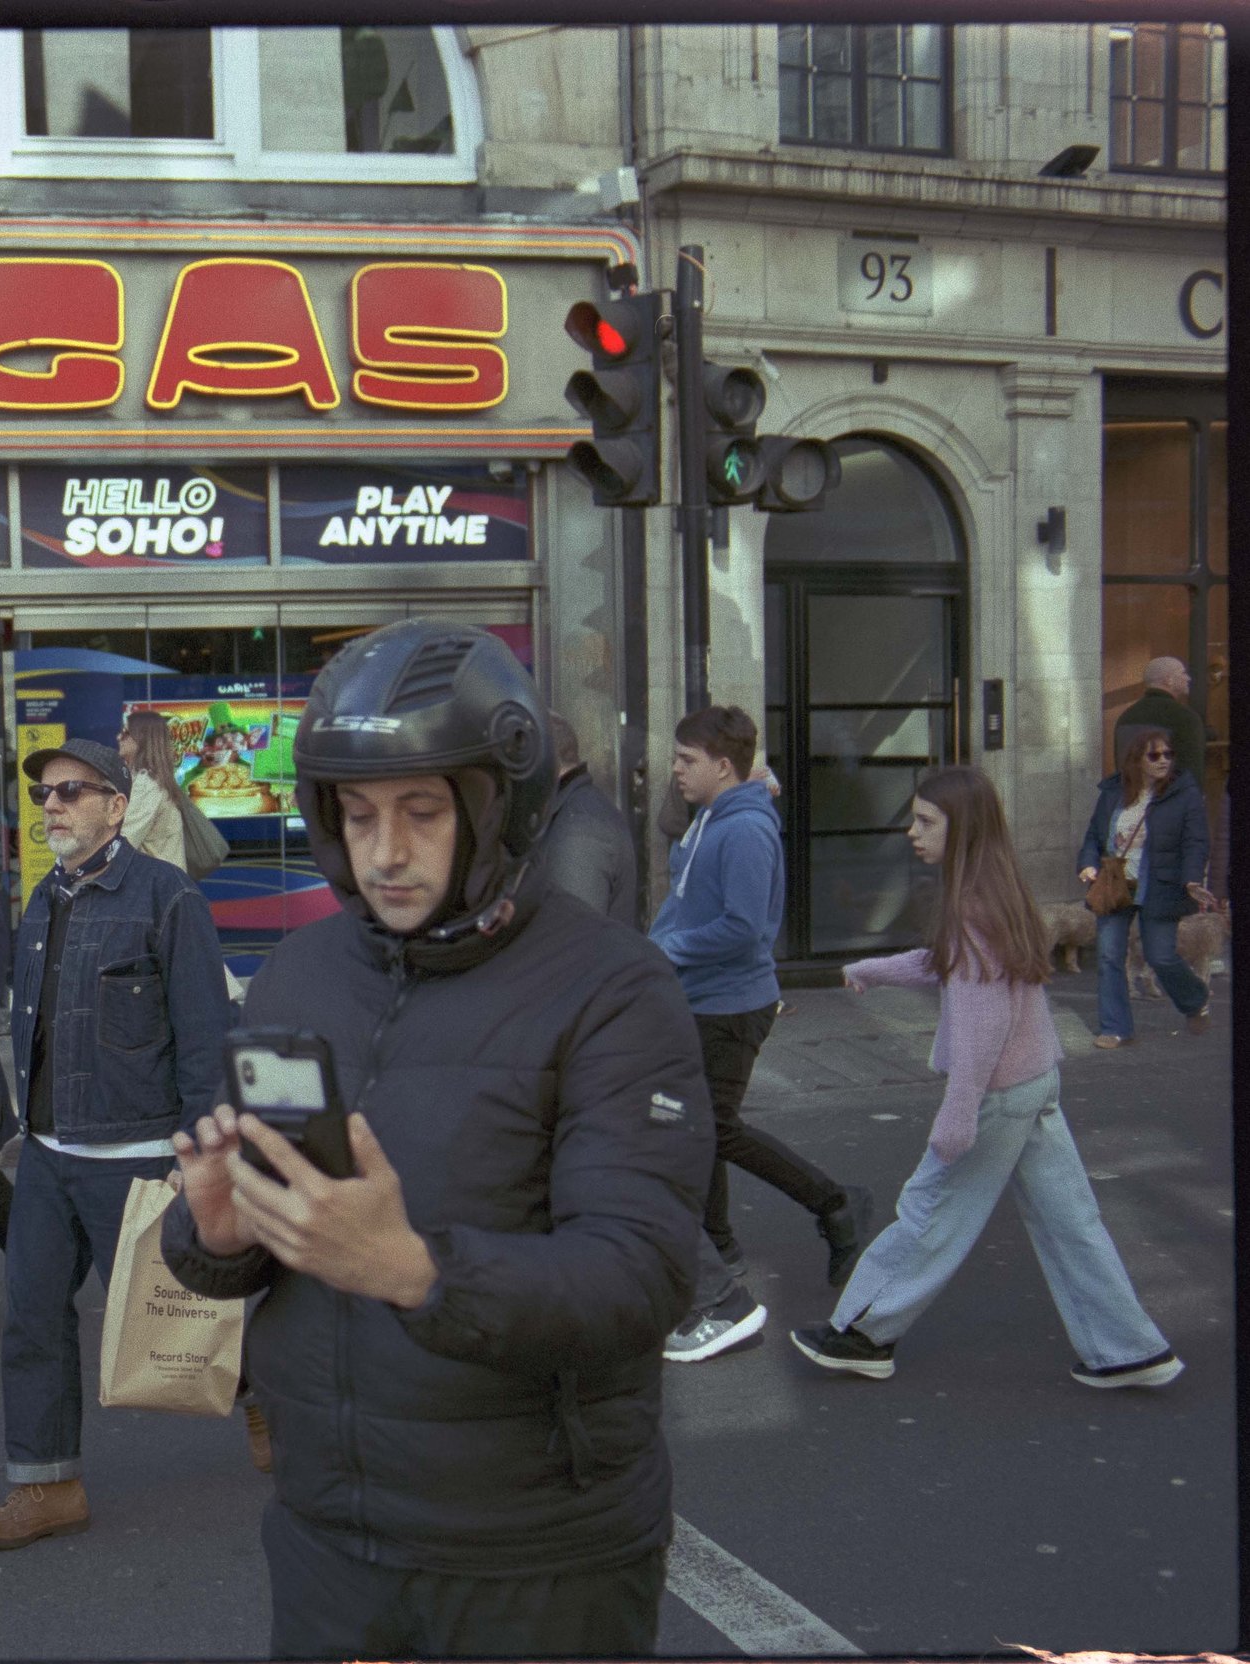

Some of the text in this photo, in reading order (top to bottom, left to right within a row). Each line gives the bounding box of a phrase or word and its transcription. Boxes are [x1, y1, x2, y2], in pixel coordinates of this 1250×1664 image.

[860, 251, 914, 303] 93
[62, 477, 217, 516] HELLO
[356, 485, 453, 515] PLAY
[63, 516, 225, 559] SOHO!
[318, 514, 489, 546] ANYTIME
[311, 715, 403, 735] LS2
[154, 1285, 193, 1301] Sounds
[145, 1302, 218, 1320] The Universe
[150, 1350, 209, 1364] Record Store
